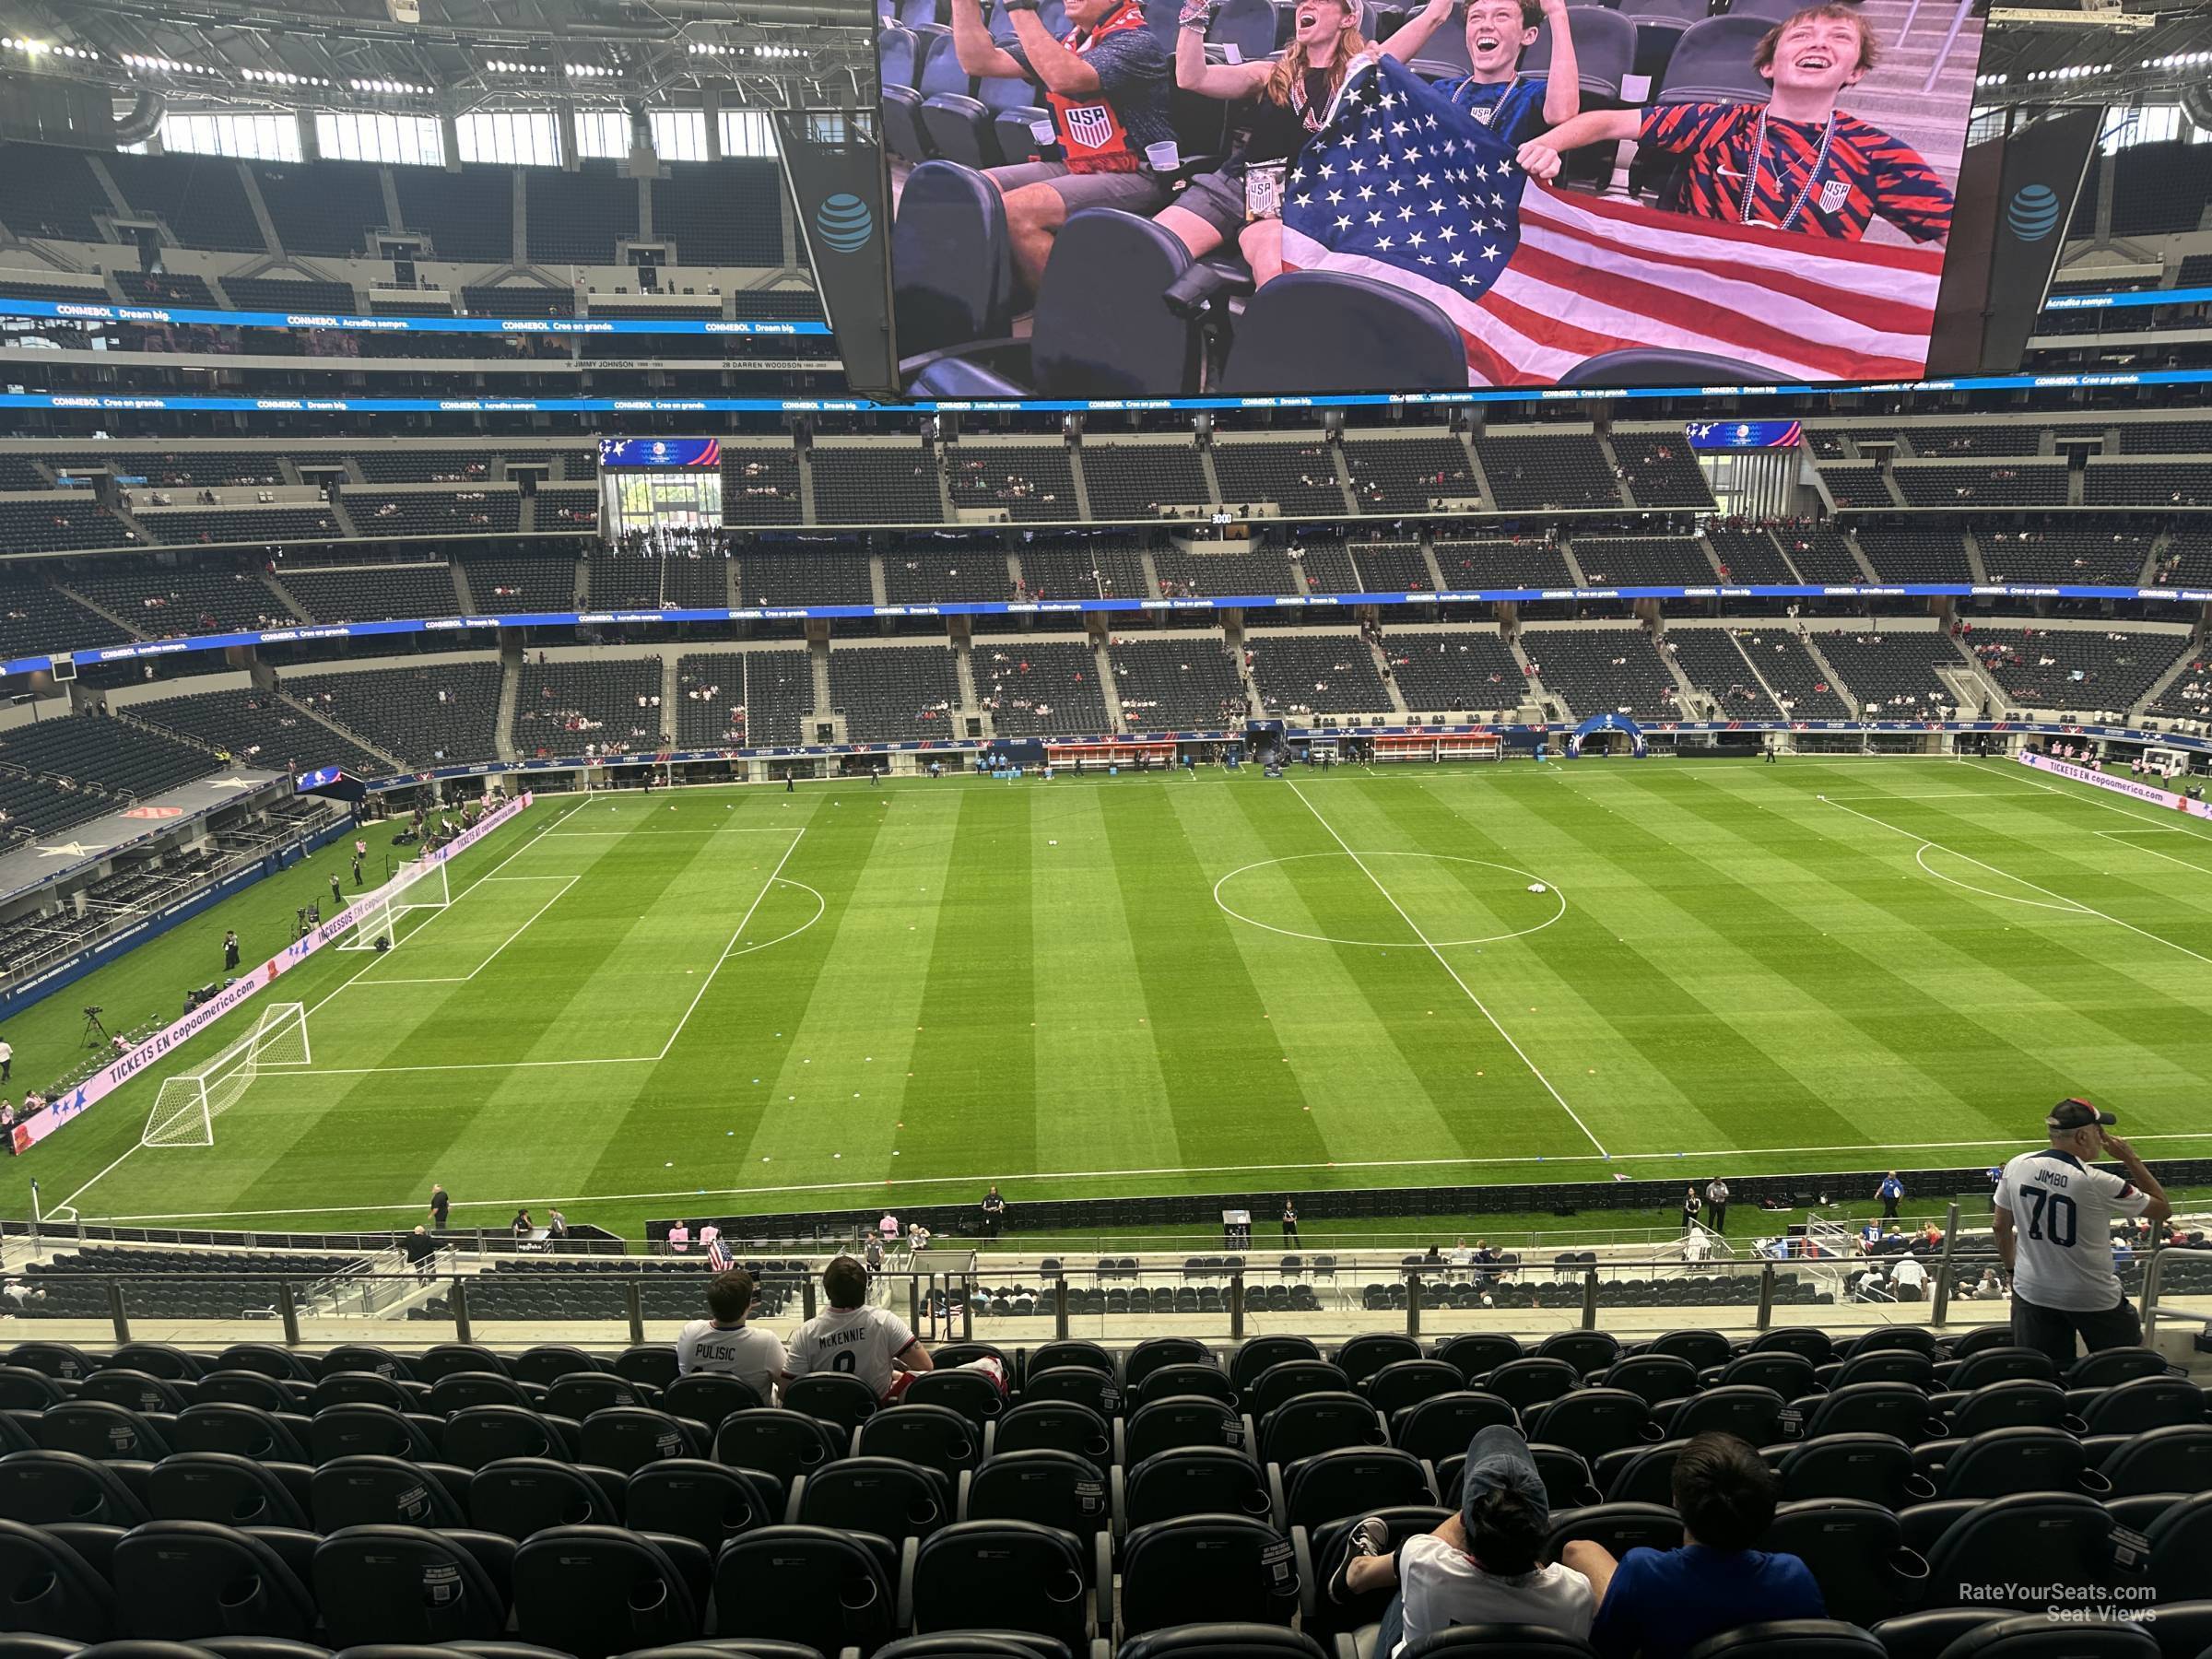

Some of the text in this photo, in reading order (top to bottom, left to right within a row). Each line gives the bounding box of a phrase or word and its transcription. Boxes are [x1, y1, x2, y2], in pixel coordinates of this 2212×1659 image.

[1068, 109, 1105, 125] USA
[1472, 109, 1489, 117] USA
[1252, 183, 1271, 195] USA
[1826, 182, 1849, 196] USA
[57, 305, 113, 316] CONMEBOL
[120, 310, 151, 318] Dream
[288, 316, 339, 325] CONMEBOL
[502, 322, 549, 330] CONMEBOL
[2035, 377, 2078, 385] CONMEBOL
[1212, 514, 1232, 524] 30:00
[2138, 590, 2178, 598] CONMEBOL
[261, 631, 298, 641] CONMEBOL
[101, 648, 136, 659] CONMEBOL
[2051, 761, 2078, 777] TICKETS
[2079, 771, 2089, 782] EN
[457, 831, 475, 849] TICKETS
[318, 912, 353, 943] INGRESSOS
[109, 980, 254, 1083] TICKETS EN copaamerica.com
[2034, 1169, 2068, 1188] JIMBO
[2019, 1184, 2077, 1248] 70
[1868, 1230, 1878, 1241] 10
[819, 1327, 865, 1349] McKENNIE
[696, 1344, 735, 1361] PULISIC
